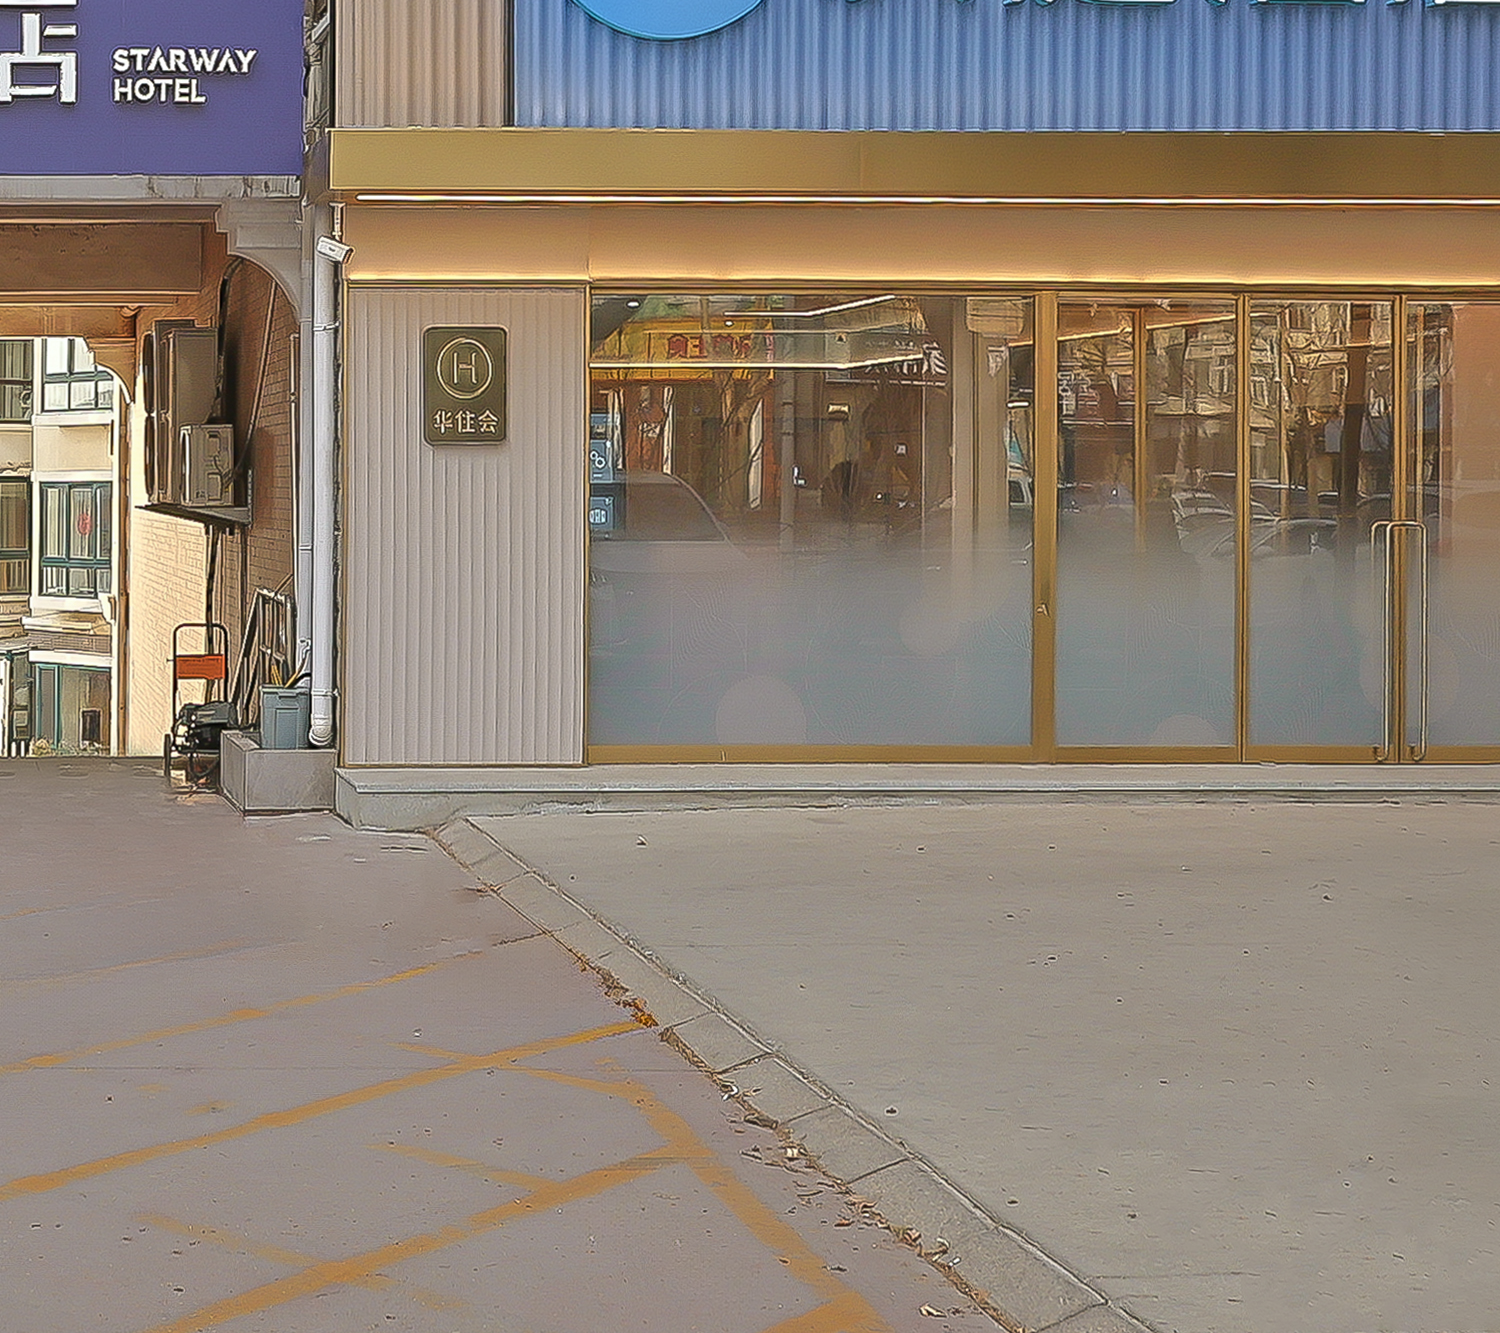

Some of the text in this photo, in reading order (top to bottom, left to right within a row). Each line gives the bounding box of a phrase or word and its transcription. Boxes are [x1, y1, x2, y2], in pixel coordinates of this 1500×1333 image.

[112, 46, 257, 74] STARWAY
[112, 77, 207, 104] HOTEL
[433, 409, 499, 434] 华住会
